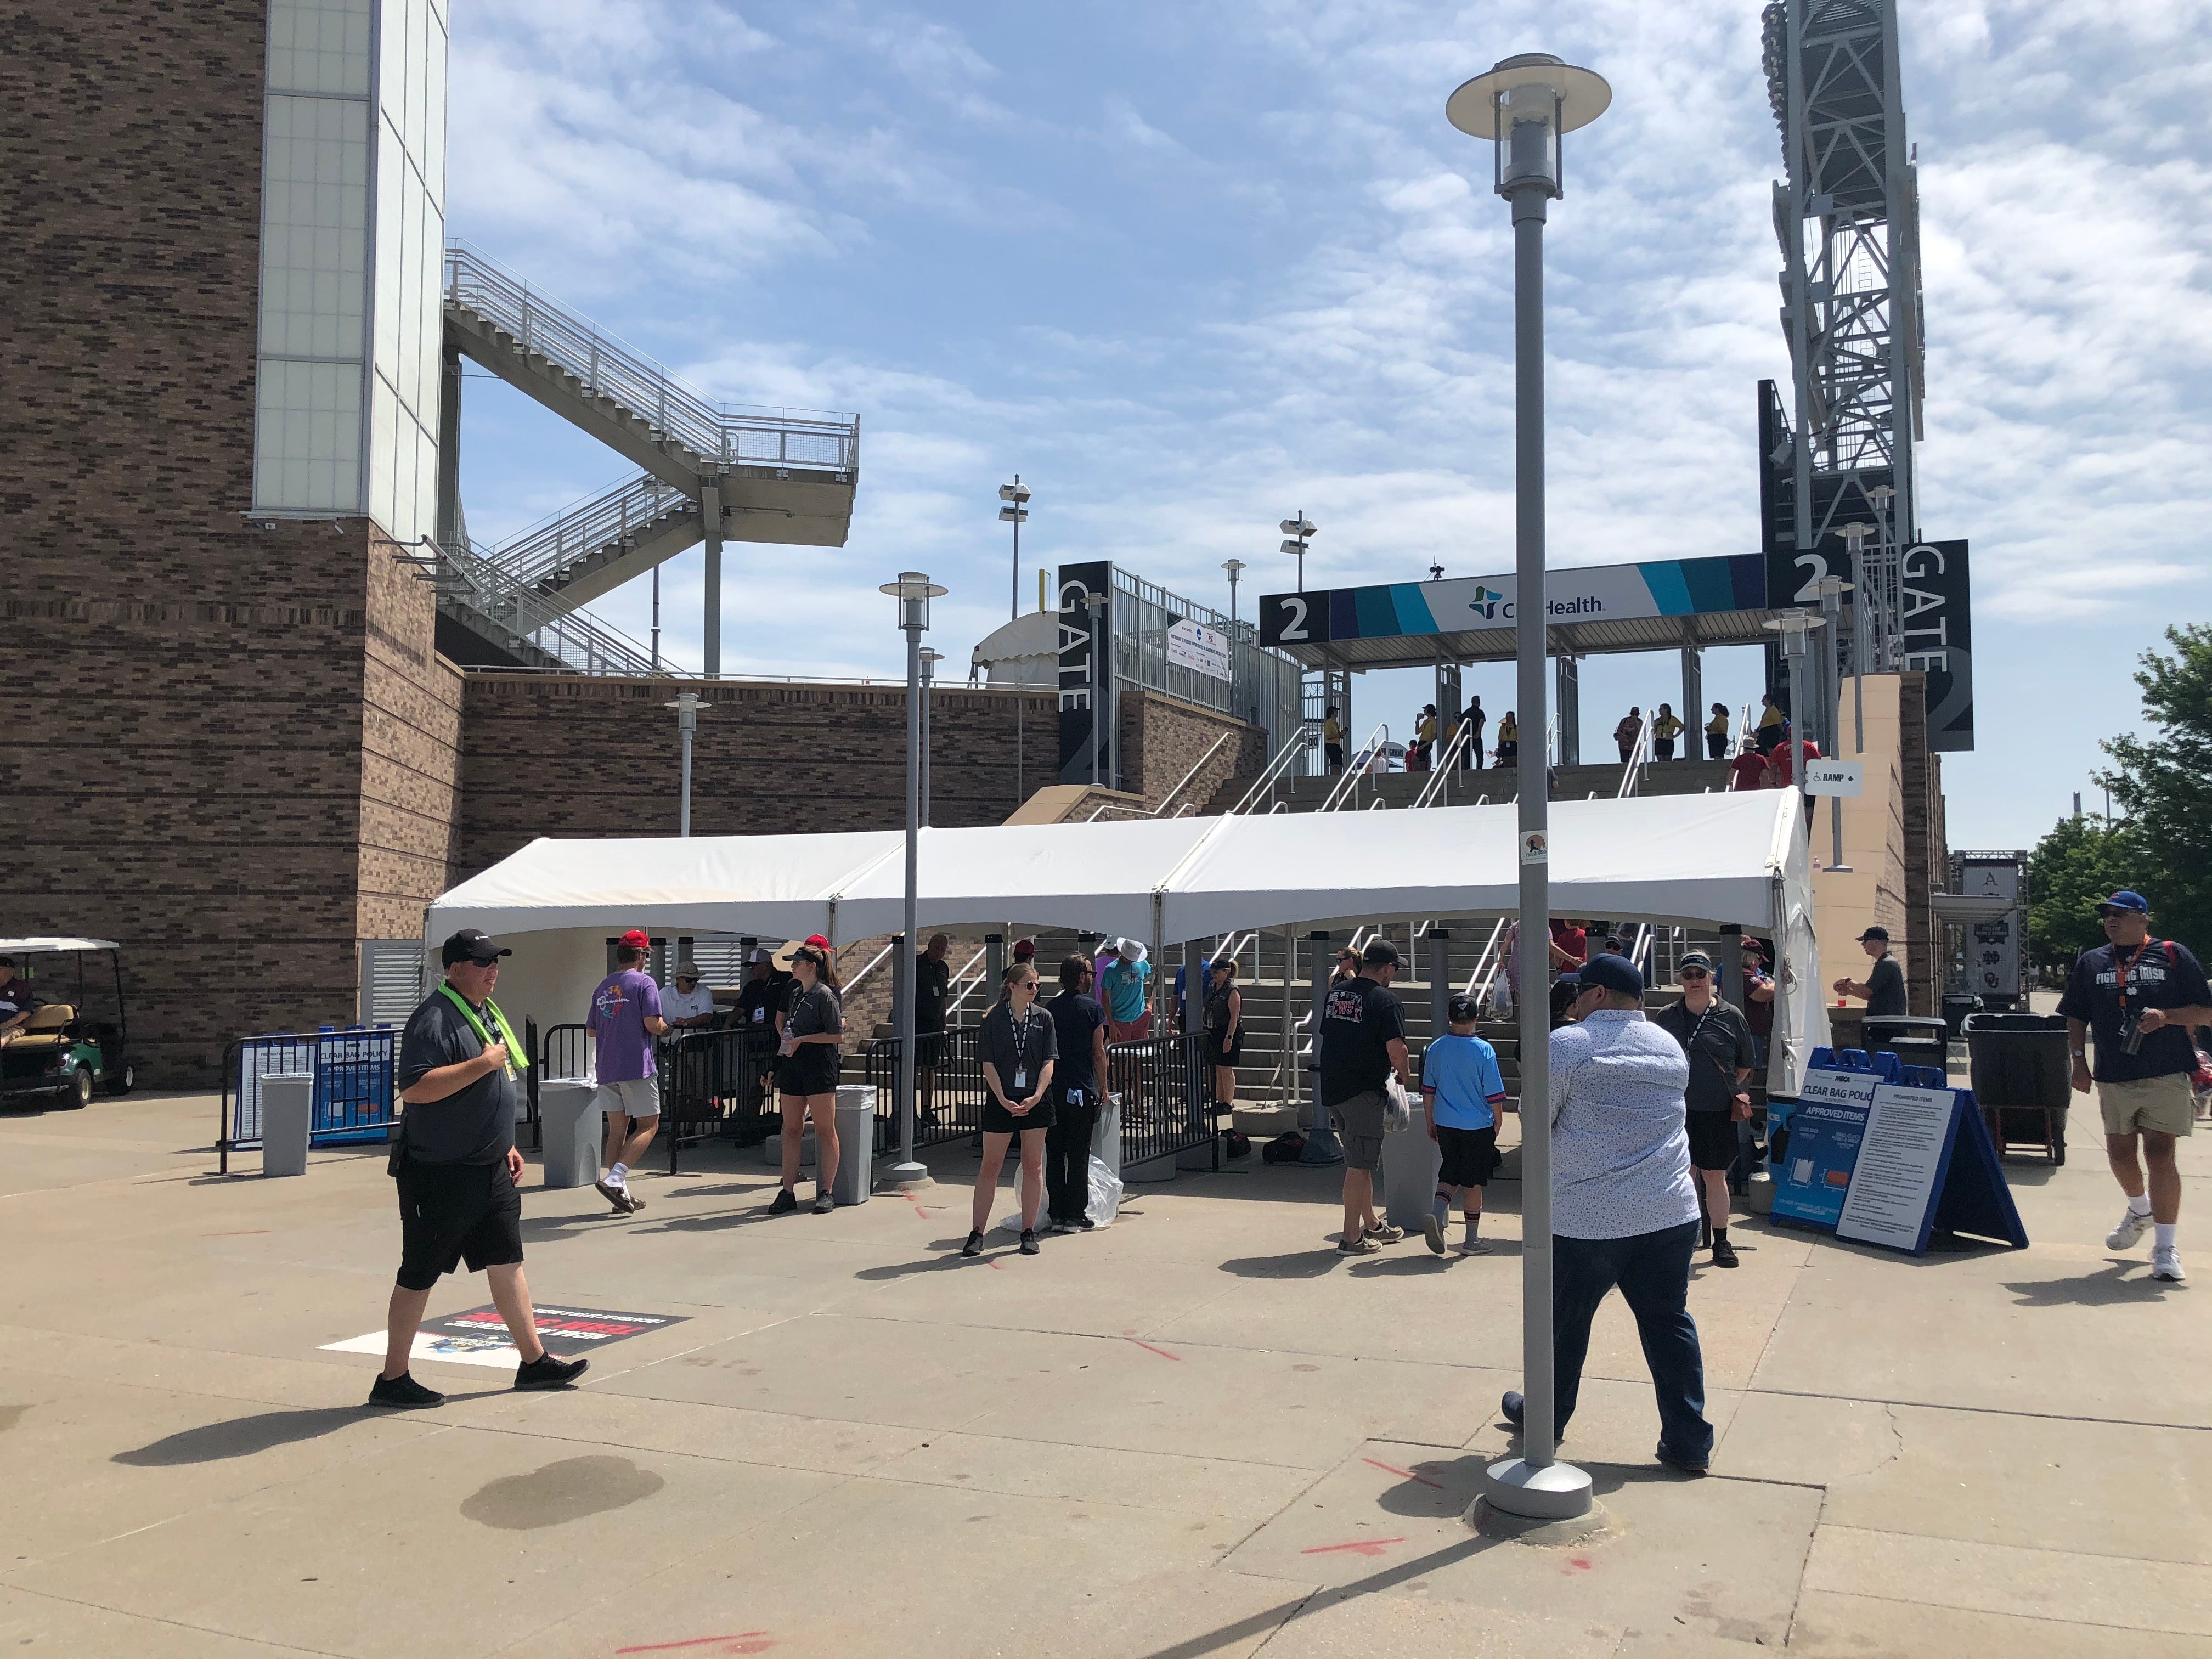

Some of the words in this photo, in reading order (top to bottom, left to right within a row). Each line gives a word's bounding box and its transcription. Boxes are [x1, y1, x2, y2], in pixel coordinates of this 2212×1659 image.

[1793, 554, 1828, 603] 2
[1902, 545, 1947, 673] GATE
[1279, 597, 1308, 641] 2
[1059, 580, 1091, 713] GATE
[1822, 773, 1844, 782] RAMP
[2096, 969, 2137, 985] FIGHNG
[1331, 1000, 1355, 1014] CWS
[1803, 1085, 1828, 1096] CLEAR
[1829, 1088, 1847, 1098] BAG
[1848, 1090, 1873, 1102] POLIC
[1806, 1106, 1843, 1119] APPROVED
[1843, 1111, 1865, 1121] ITEMS
